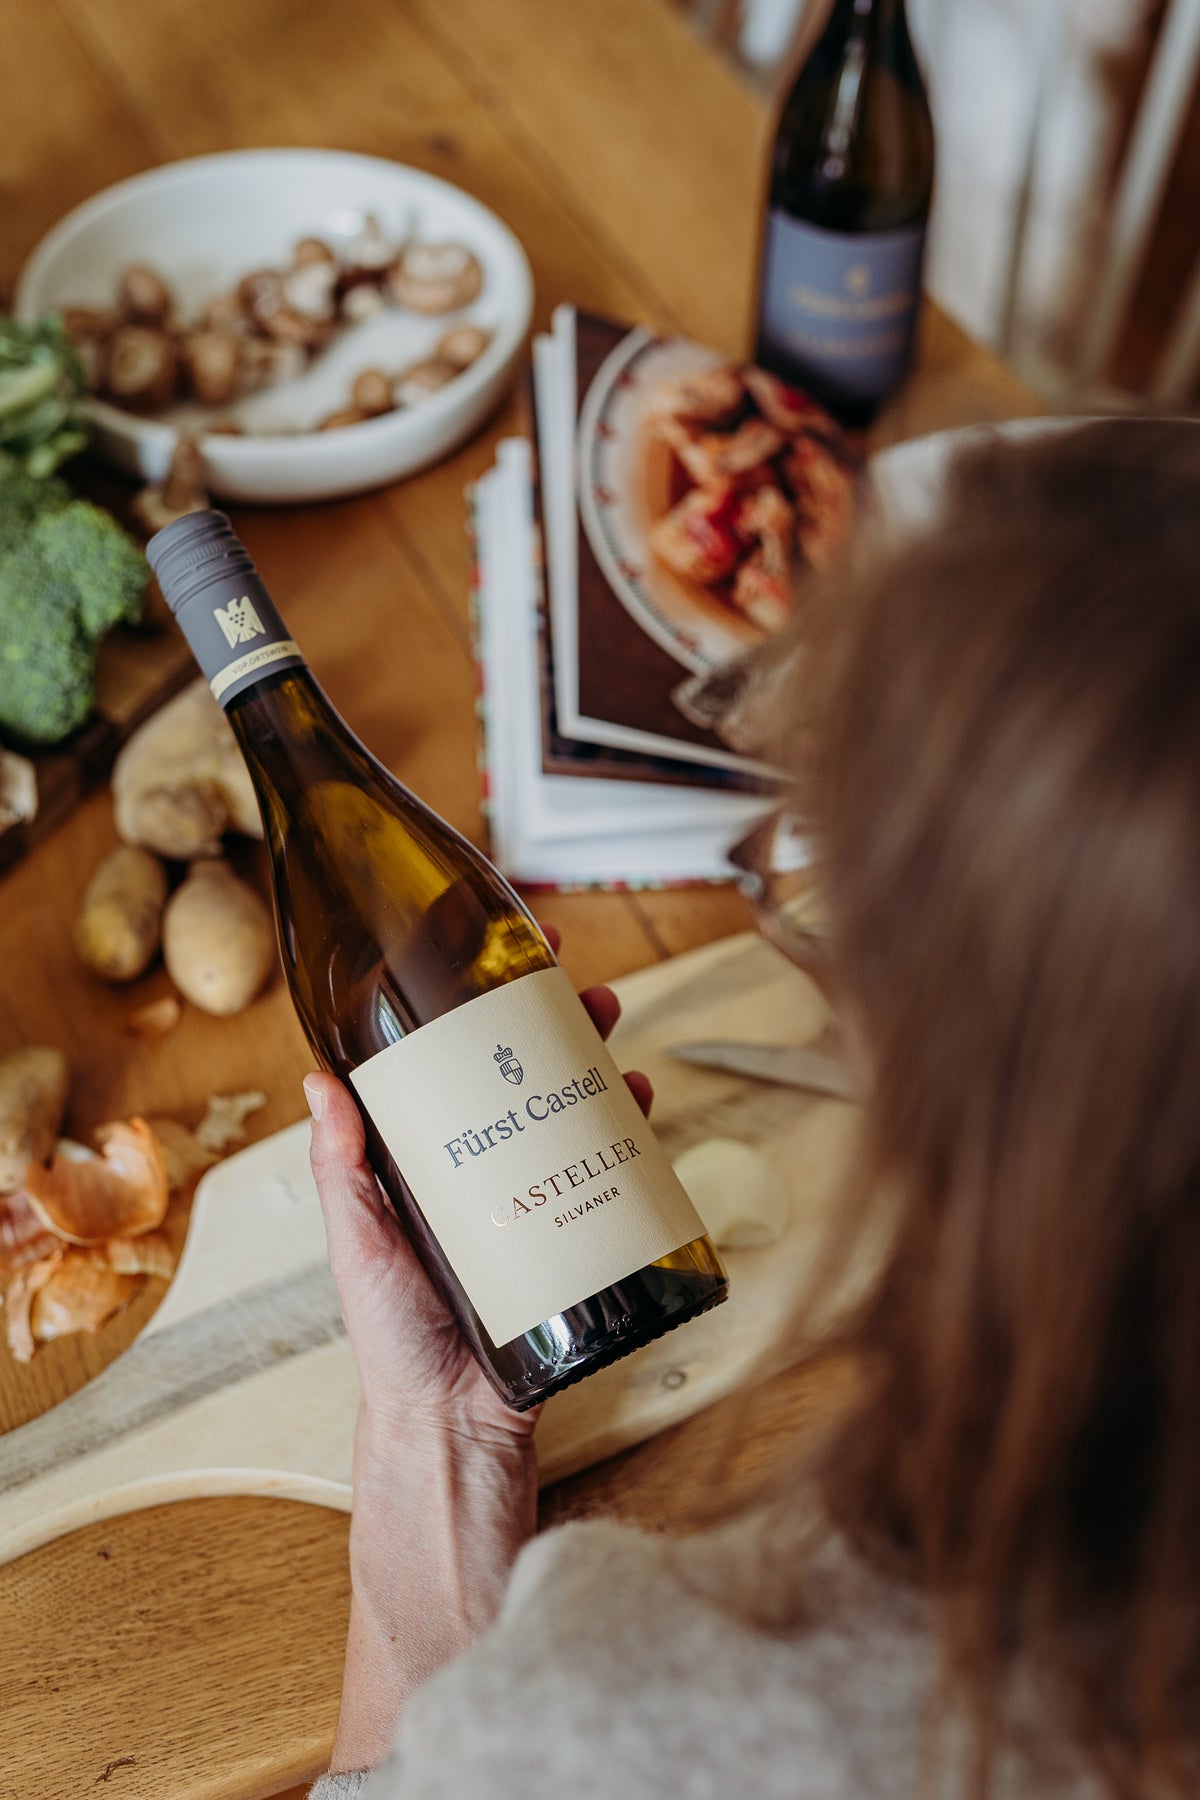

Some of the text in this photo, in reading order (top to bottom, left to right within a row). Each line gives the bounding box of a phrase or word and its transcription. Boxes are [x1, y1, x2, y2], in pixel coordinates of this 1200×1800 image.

[443, 1067, 608, 1168] Fürst Castell
[490, 1138, 642, 1228] CASTELLER
[554, 1187, 621, 1227] SILVANER
